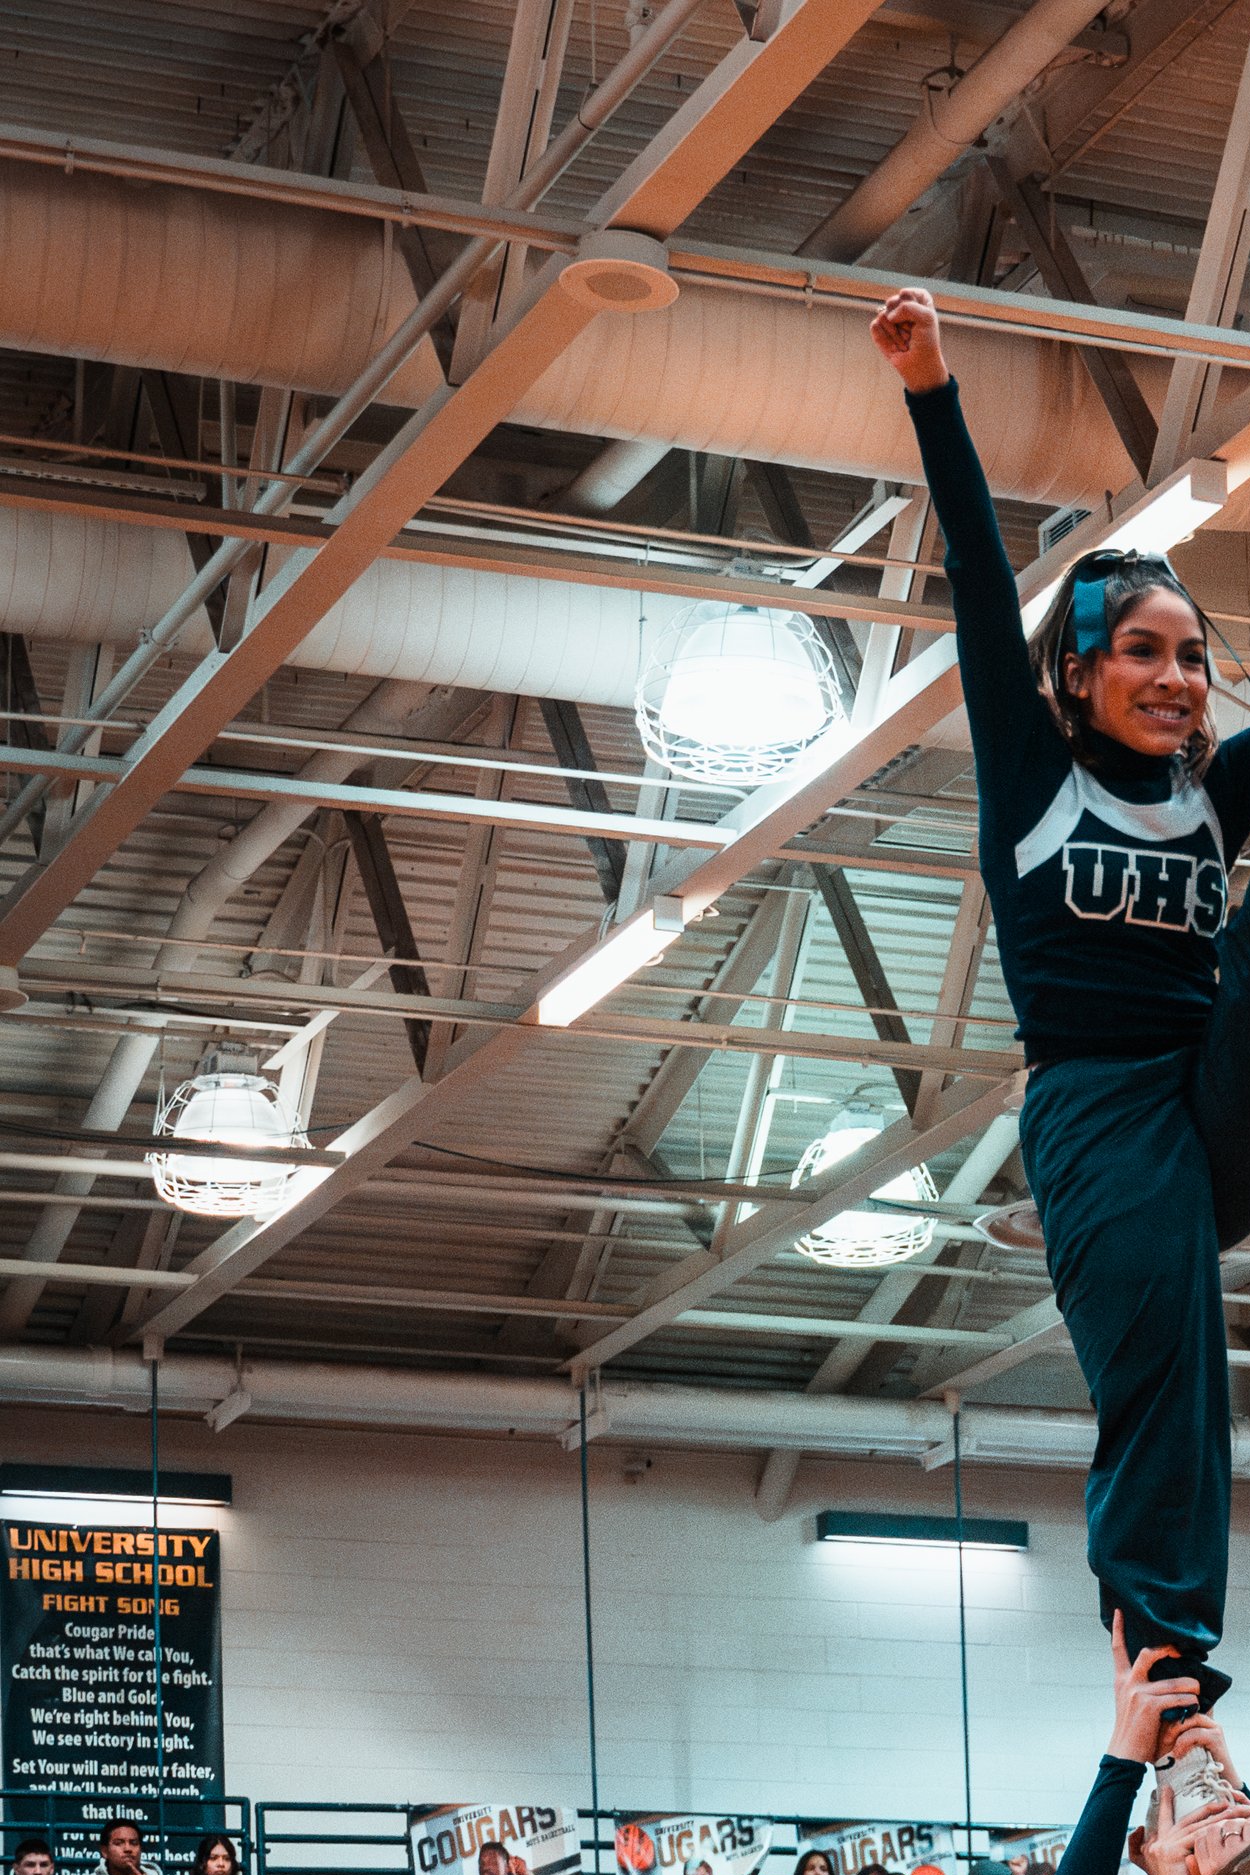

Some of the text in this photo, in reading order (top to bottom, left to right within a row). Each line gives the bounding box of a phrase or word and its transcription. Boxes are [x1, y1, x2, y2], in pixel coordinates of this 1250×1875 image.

[1062, 841, 1229, 938] UHS
[8, 1527, 211, 1558] UNIVERSITY
[8, 1557, 214, 1588] HIGH SCHOOL
[42, 1594, 180, 1616] FIGHT SONG
[64, 1622, 156, 1642] Cougar Pride
[73, 1645, 111, 1661] what
[113, 1646, 135, 1661] We
[165, 1648, 195, 1666] You,
[11, 1664, 51, 1681] Catch
[54, 1665, 79, 1681] the
[82, 1667, 120, 1685] spirit
[122, 1668, 143, 1683] for
[172, 1669, 213, 1689] fight.
[62, 1687, 95, 1704] Blue
[97, 1689, 125, 1704] and
[30, 1708, 71, 1724] We're
[74, 1709, 110, 1728] right
[165, 1712, 195, 1730] You,
[32, 1730, 55, 1745] We
[57, 1734, 82, 1746] see
[85, 1732, 134, 1751] victory
[137, 1733, 151, 1748] in
[12, 1759, 36, 1774] Set
[38, 1760, 70, 1775] Your
[72, 1760, 99, 1776] will
[100, 1761, 127, 1776] and
[171, 1763, 216, 1781] falter,
[81, 1803, 149, 1821] that line.
[452, 1805, 492, 1826] UNIVERSITY
[654, 1820, 695, 1837] UNIVERSITY
[417, 1806, 557, 1874] COUGARS
[657, 1817, 755, 1868] UGARS
